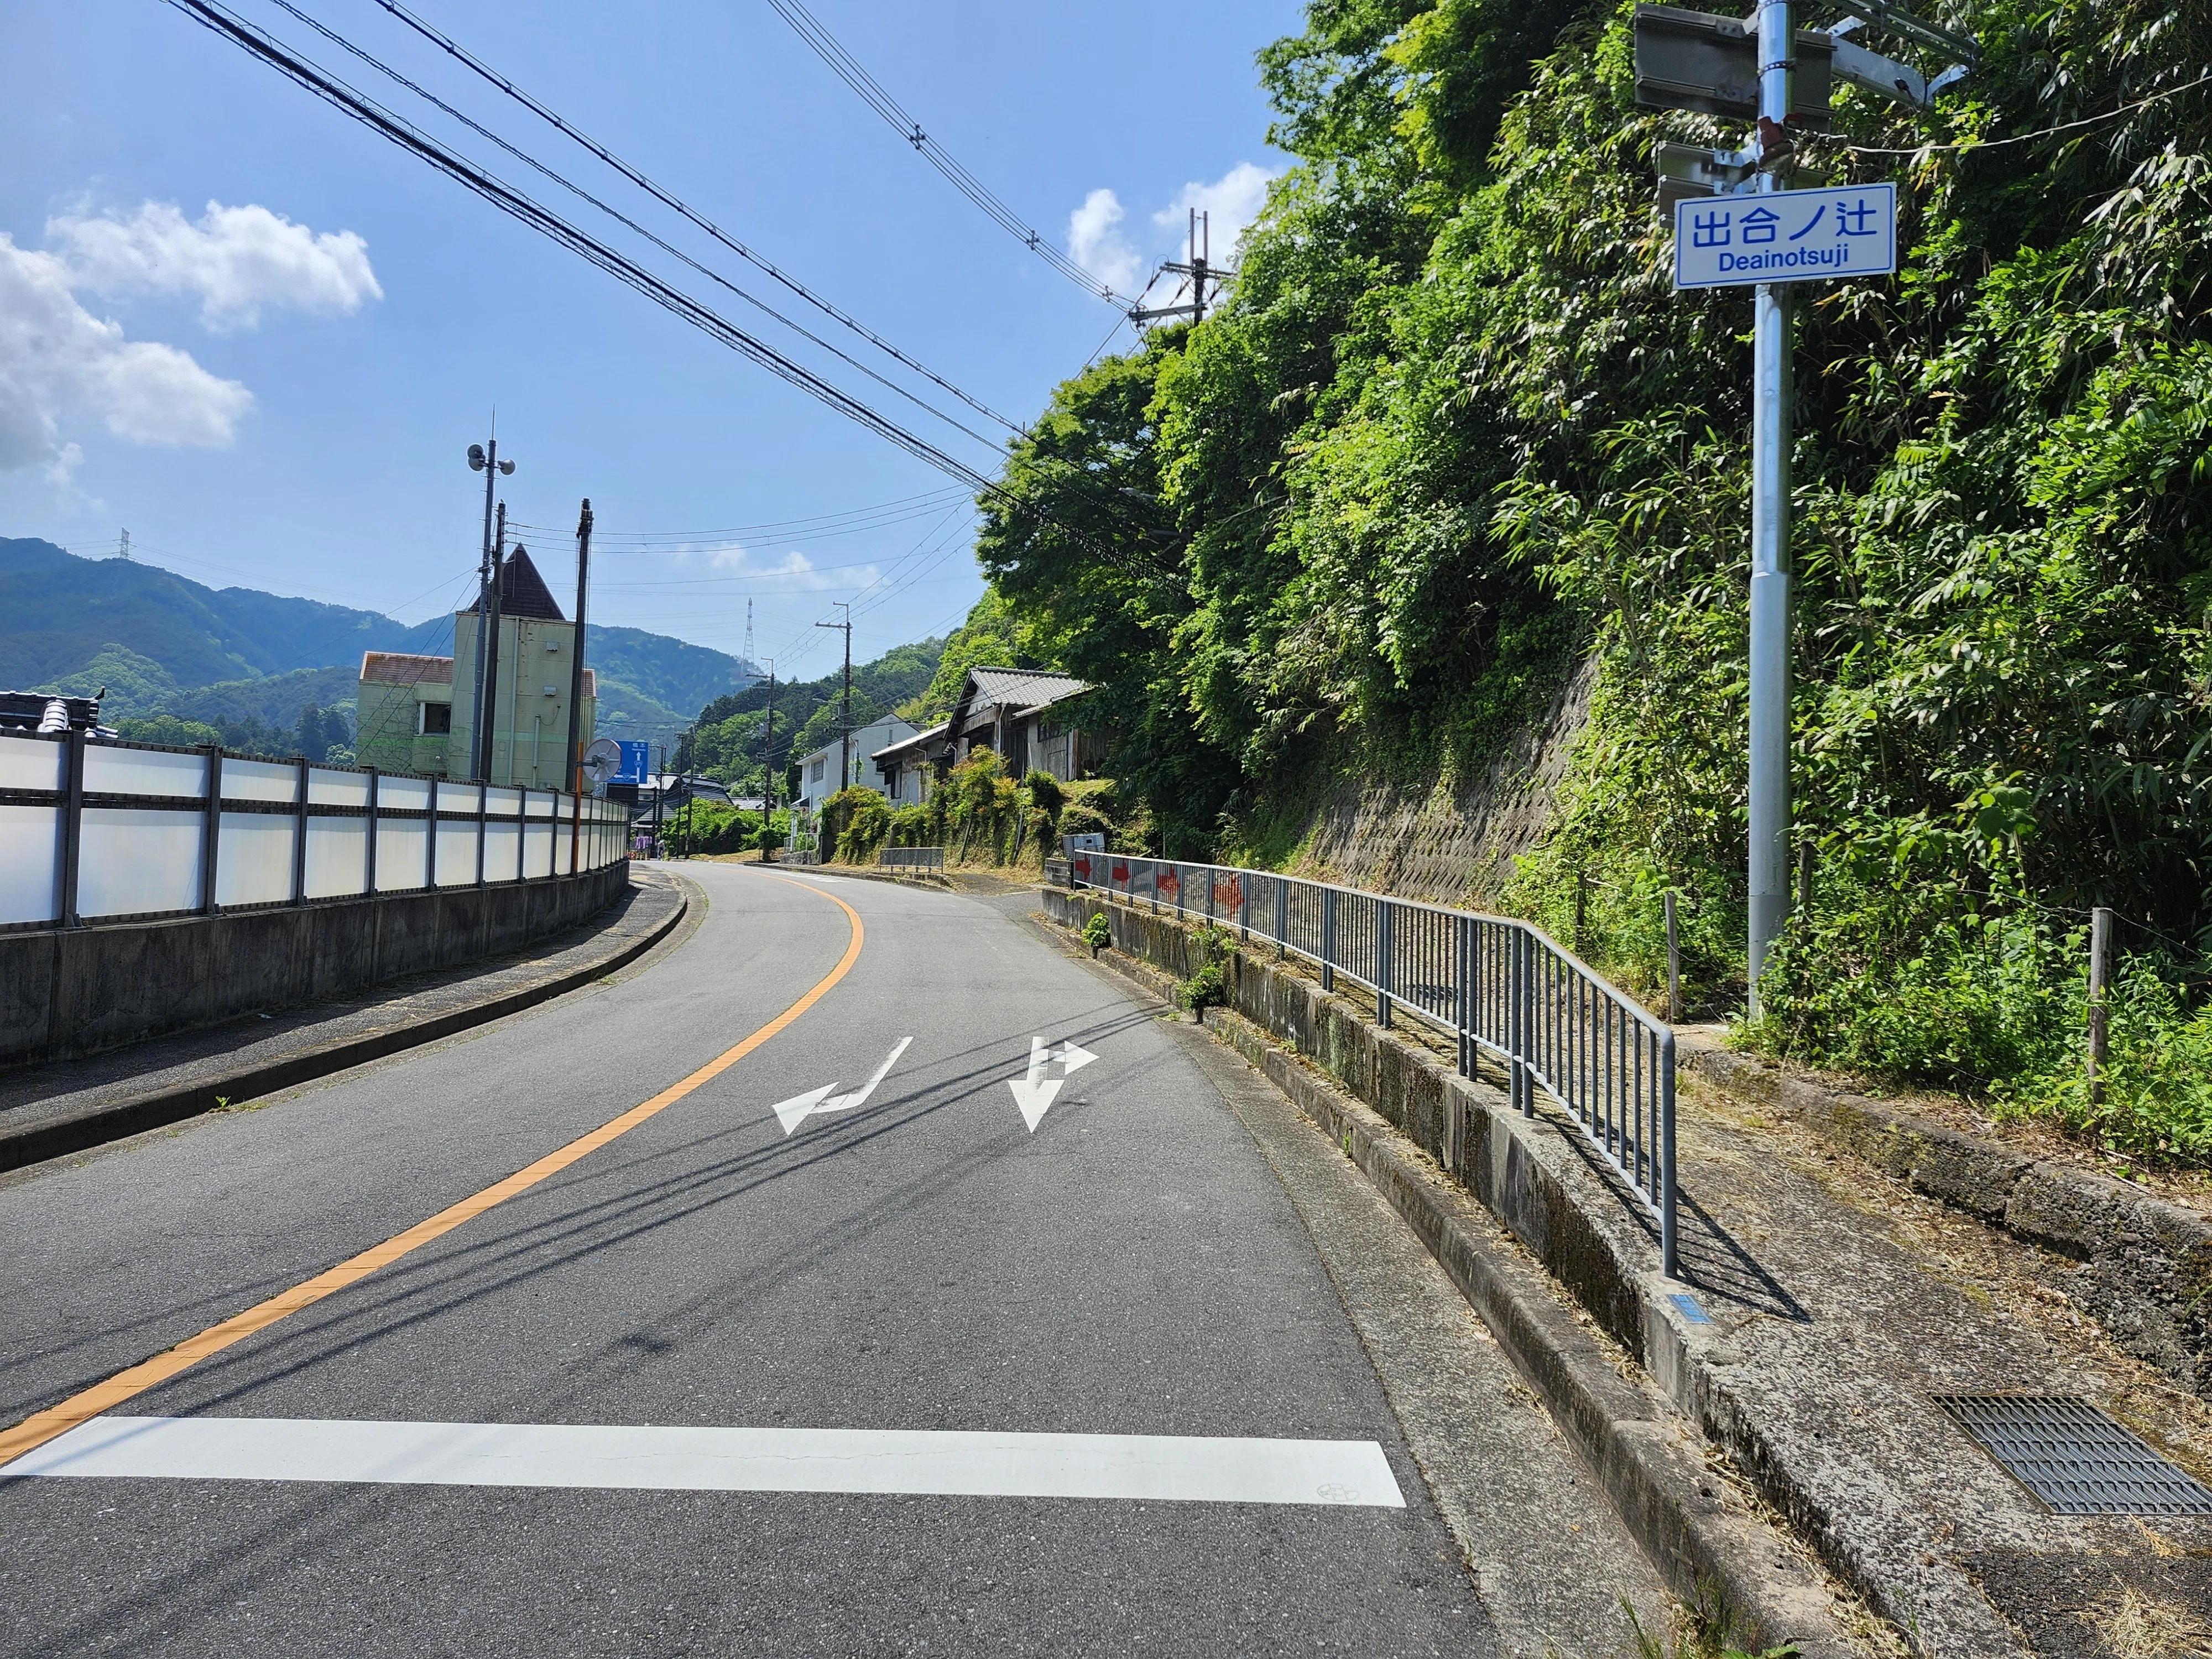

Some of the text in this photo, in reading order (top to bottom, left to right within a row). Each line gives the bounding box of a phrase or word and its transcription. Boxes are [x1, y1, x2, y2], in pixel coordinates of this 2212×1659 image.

[1693, 199, 1877, 248] 出合ノ辻
[1719, 243, 1848, 272] Deainotsuji
